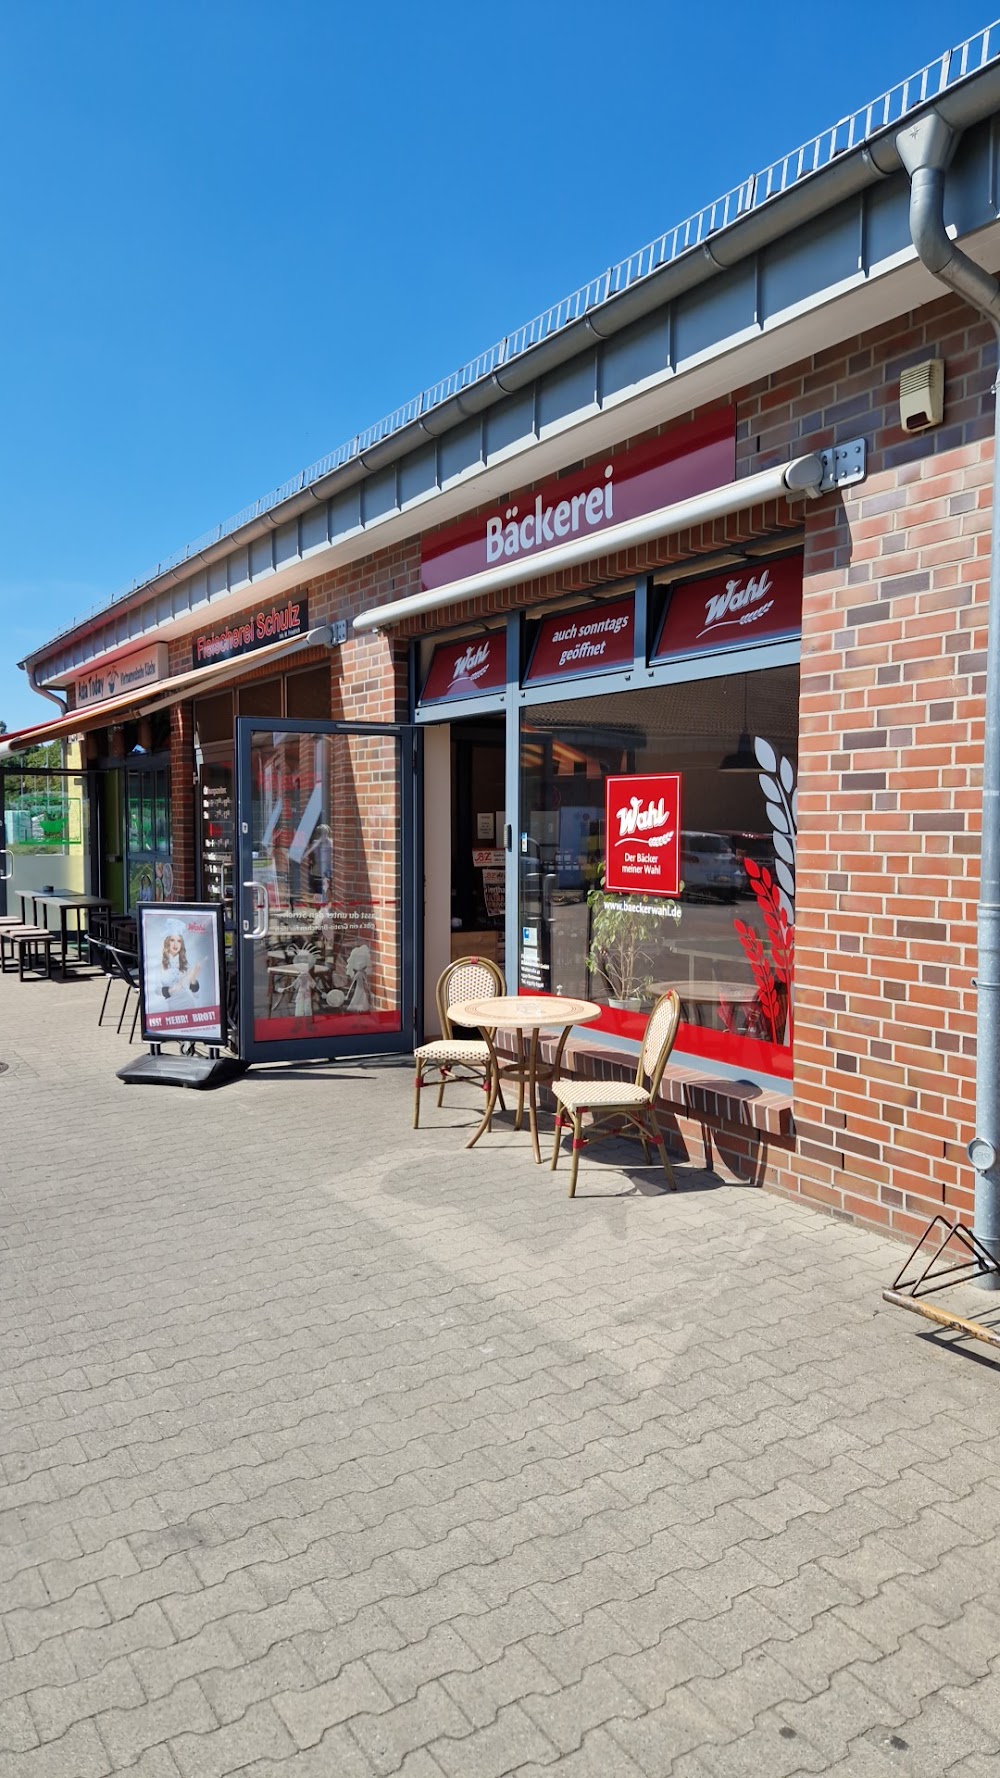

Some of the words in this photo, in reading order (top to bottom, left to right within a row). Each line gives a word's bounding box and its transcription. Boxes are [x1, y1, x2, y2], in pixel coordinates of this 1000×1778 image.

[486, 464, 614, 563] Bäckerei
[704, 570, 773, 626] Wahl
[196, 616, 255, 660] Fleischerei
[256, 600, 300, 639] Schulz
[552, 624, 578, 643] auch
[578, 615, 630, 634] sonntags
[453, 641, 490, 680] Wahl
[558, 640, 607, 666] geöffnet
[78, 681, 88, 700] Asia
[88, 674, 104, 698] Today
[616, 796, 670, 837] Wahl
[622, 864, 644, 875] meiner
[644, 865, 661, 875] Wahl
[624, 852, 636, 863] Der
[636, 853, 659, 864] Bäcker
[603, 900, 682, 918] www.baeckerwahl.de
[187, 921, 206, 932] Wahl
[149, 1017, 162, 1027] ISS!
[165, 1014, 189, 1026] MEHR!
[192, 1011, 216, 1023] BROT!
